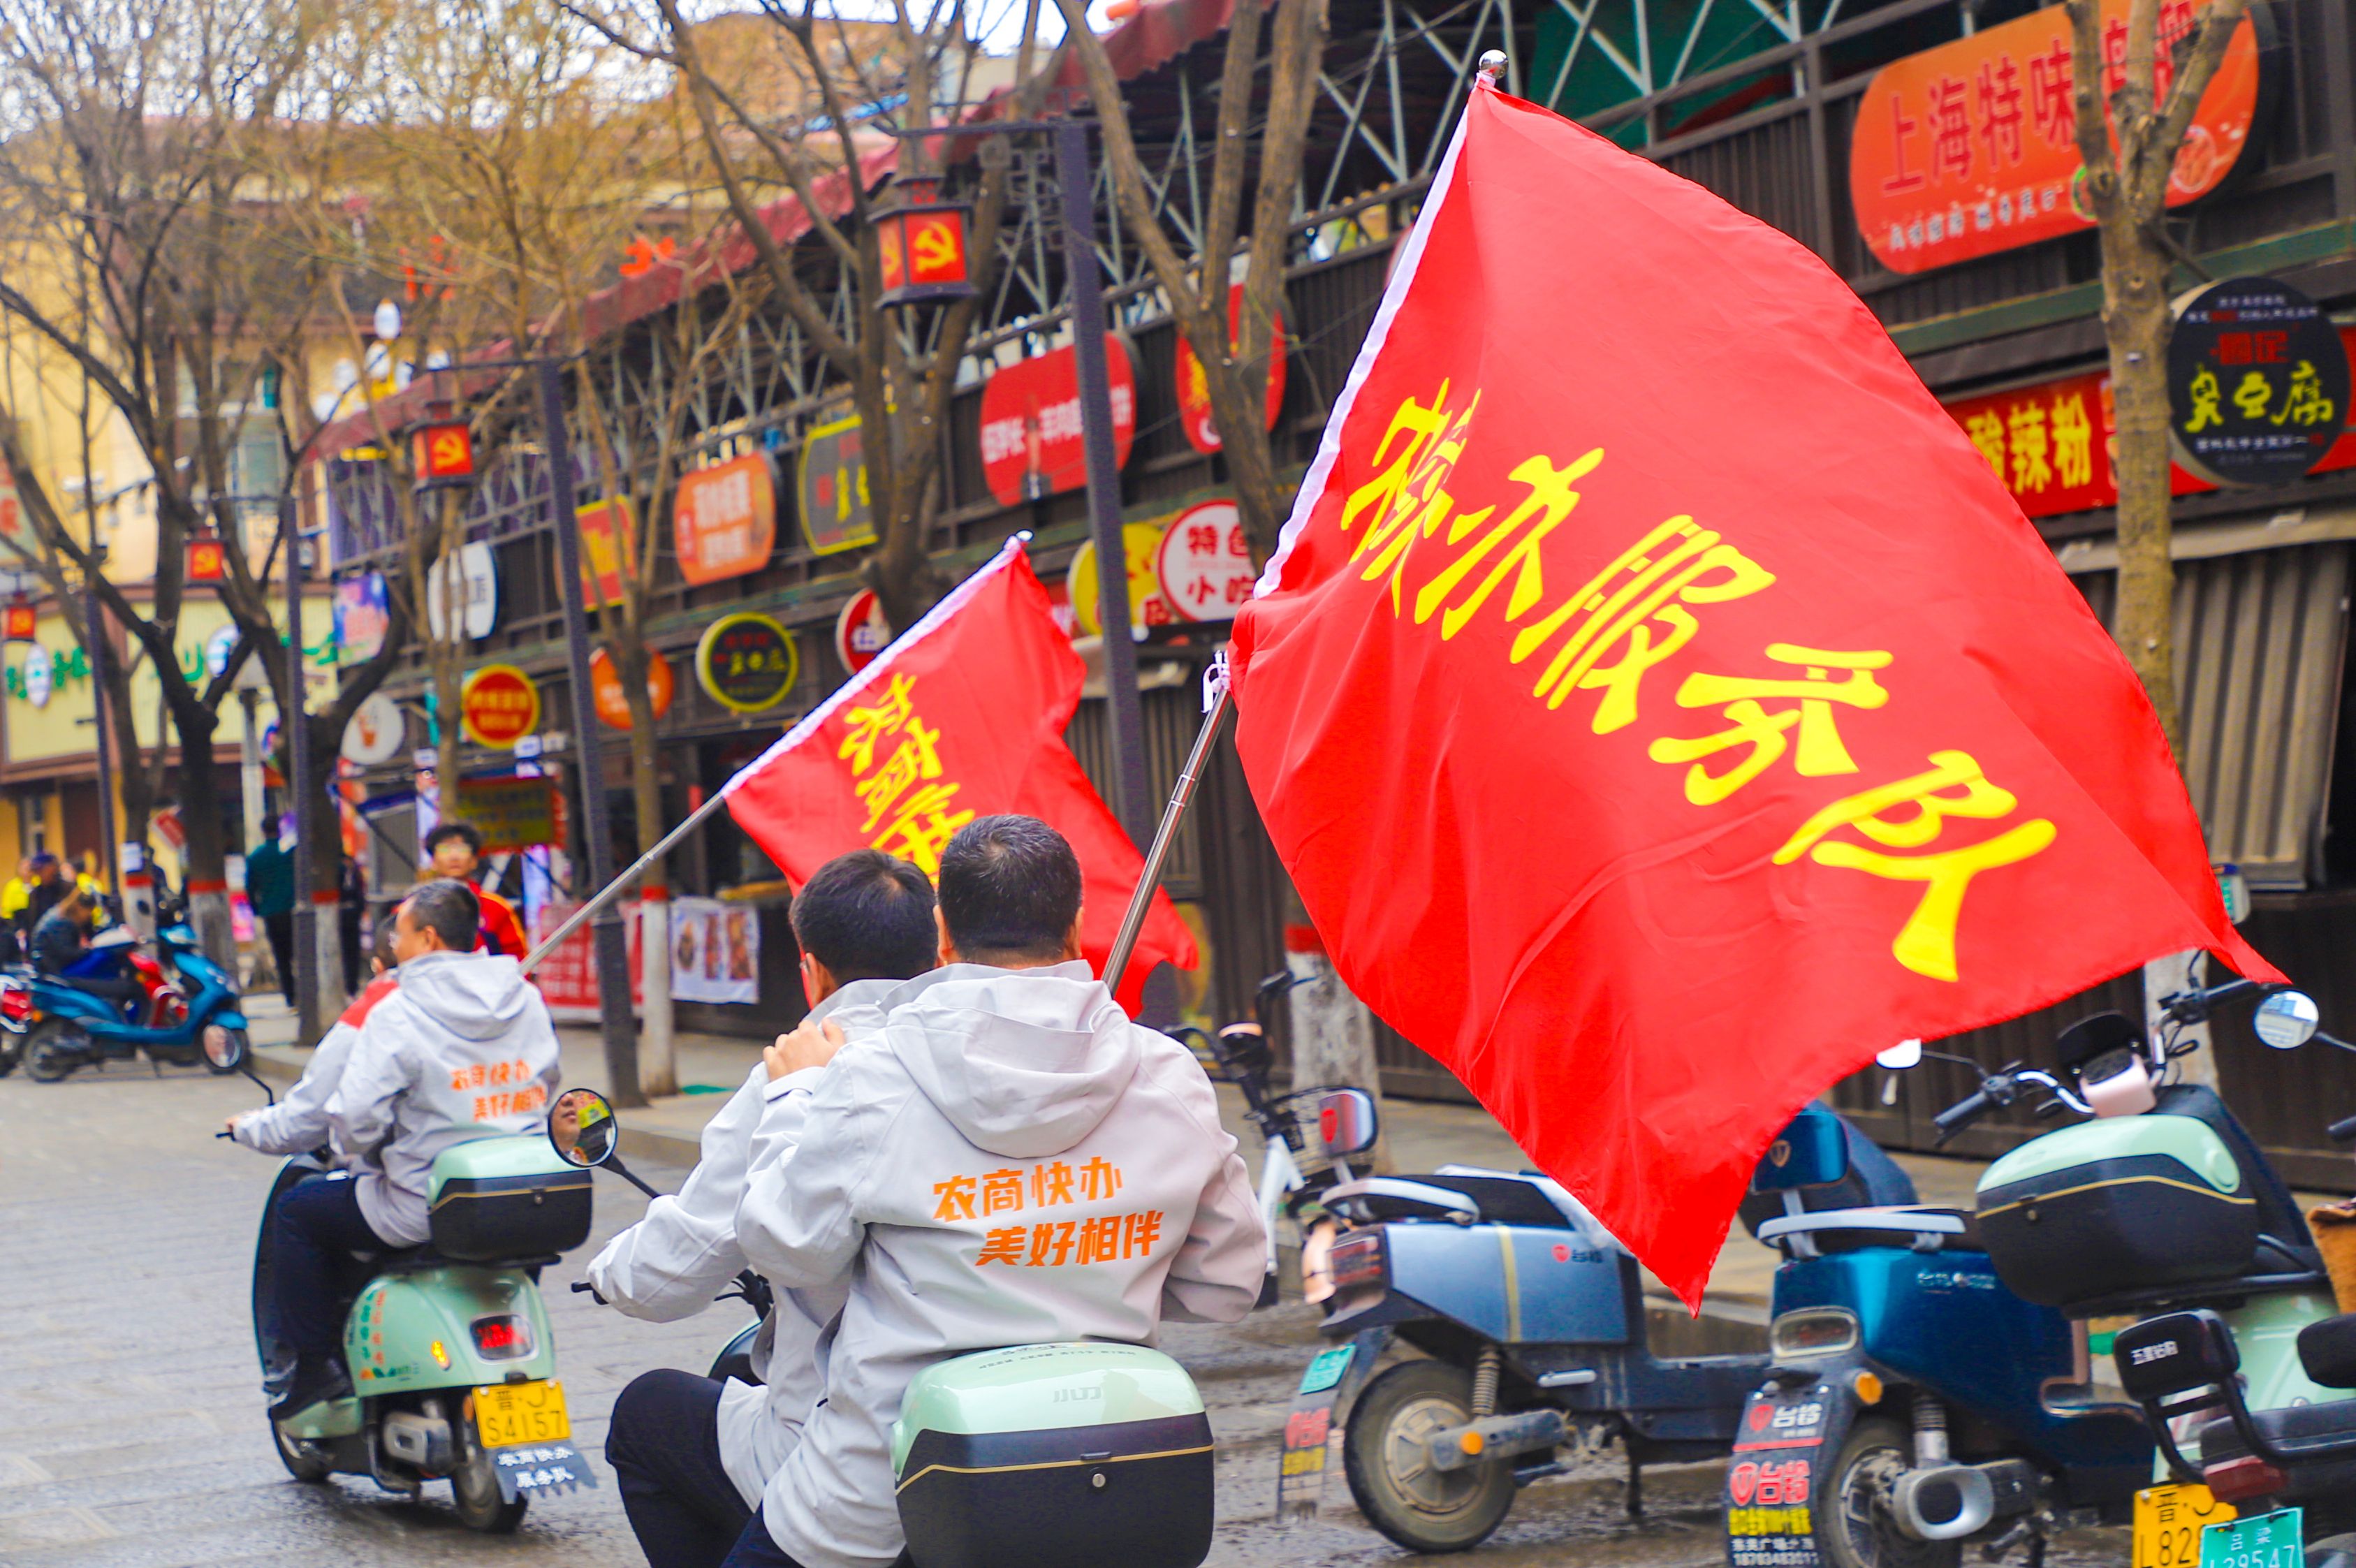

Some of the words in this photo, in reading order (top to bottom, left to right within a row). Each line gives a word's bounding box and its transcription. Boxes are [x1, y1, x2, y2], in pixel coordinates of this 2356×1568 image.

[2184, 360, 2334, 433] 臭豆腐
[1966, 393, 2093, 494] 酸辣粉
[1187, 525, 1250, 556] 特色
[1187, 574, 1256, 606] 小吃
[932, 1156, 1123, 1223] 农商快办
[974, 1210, 1165, 1267] 美好相伴
[485, 1410, 563, 1442] S4157
[2139, 1527, 2201, 1568] L82
